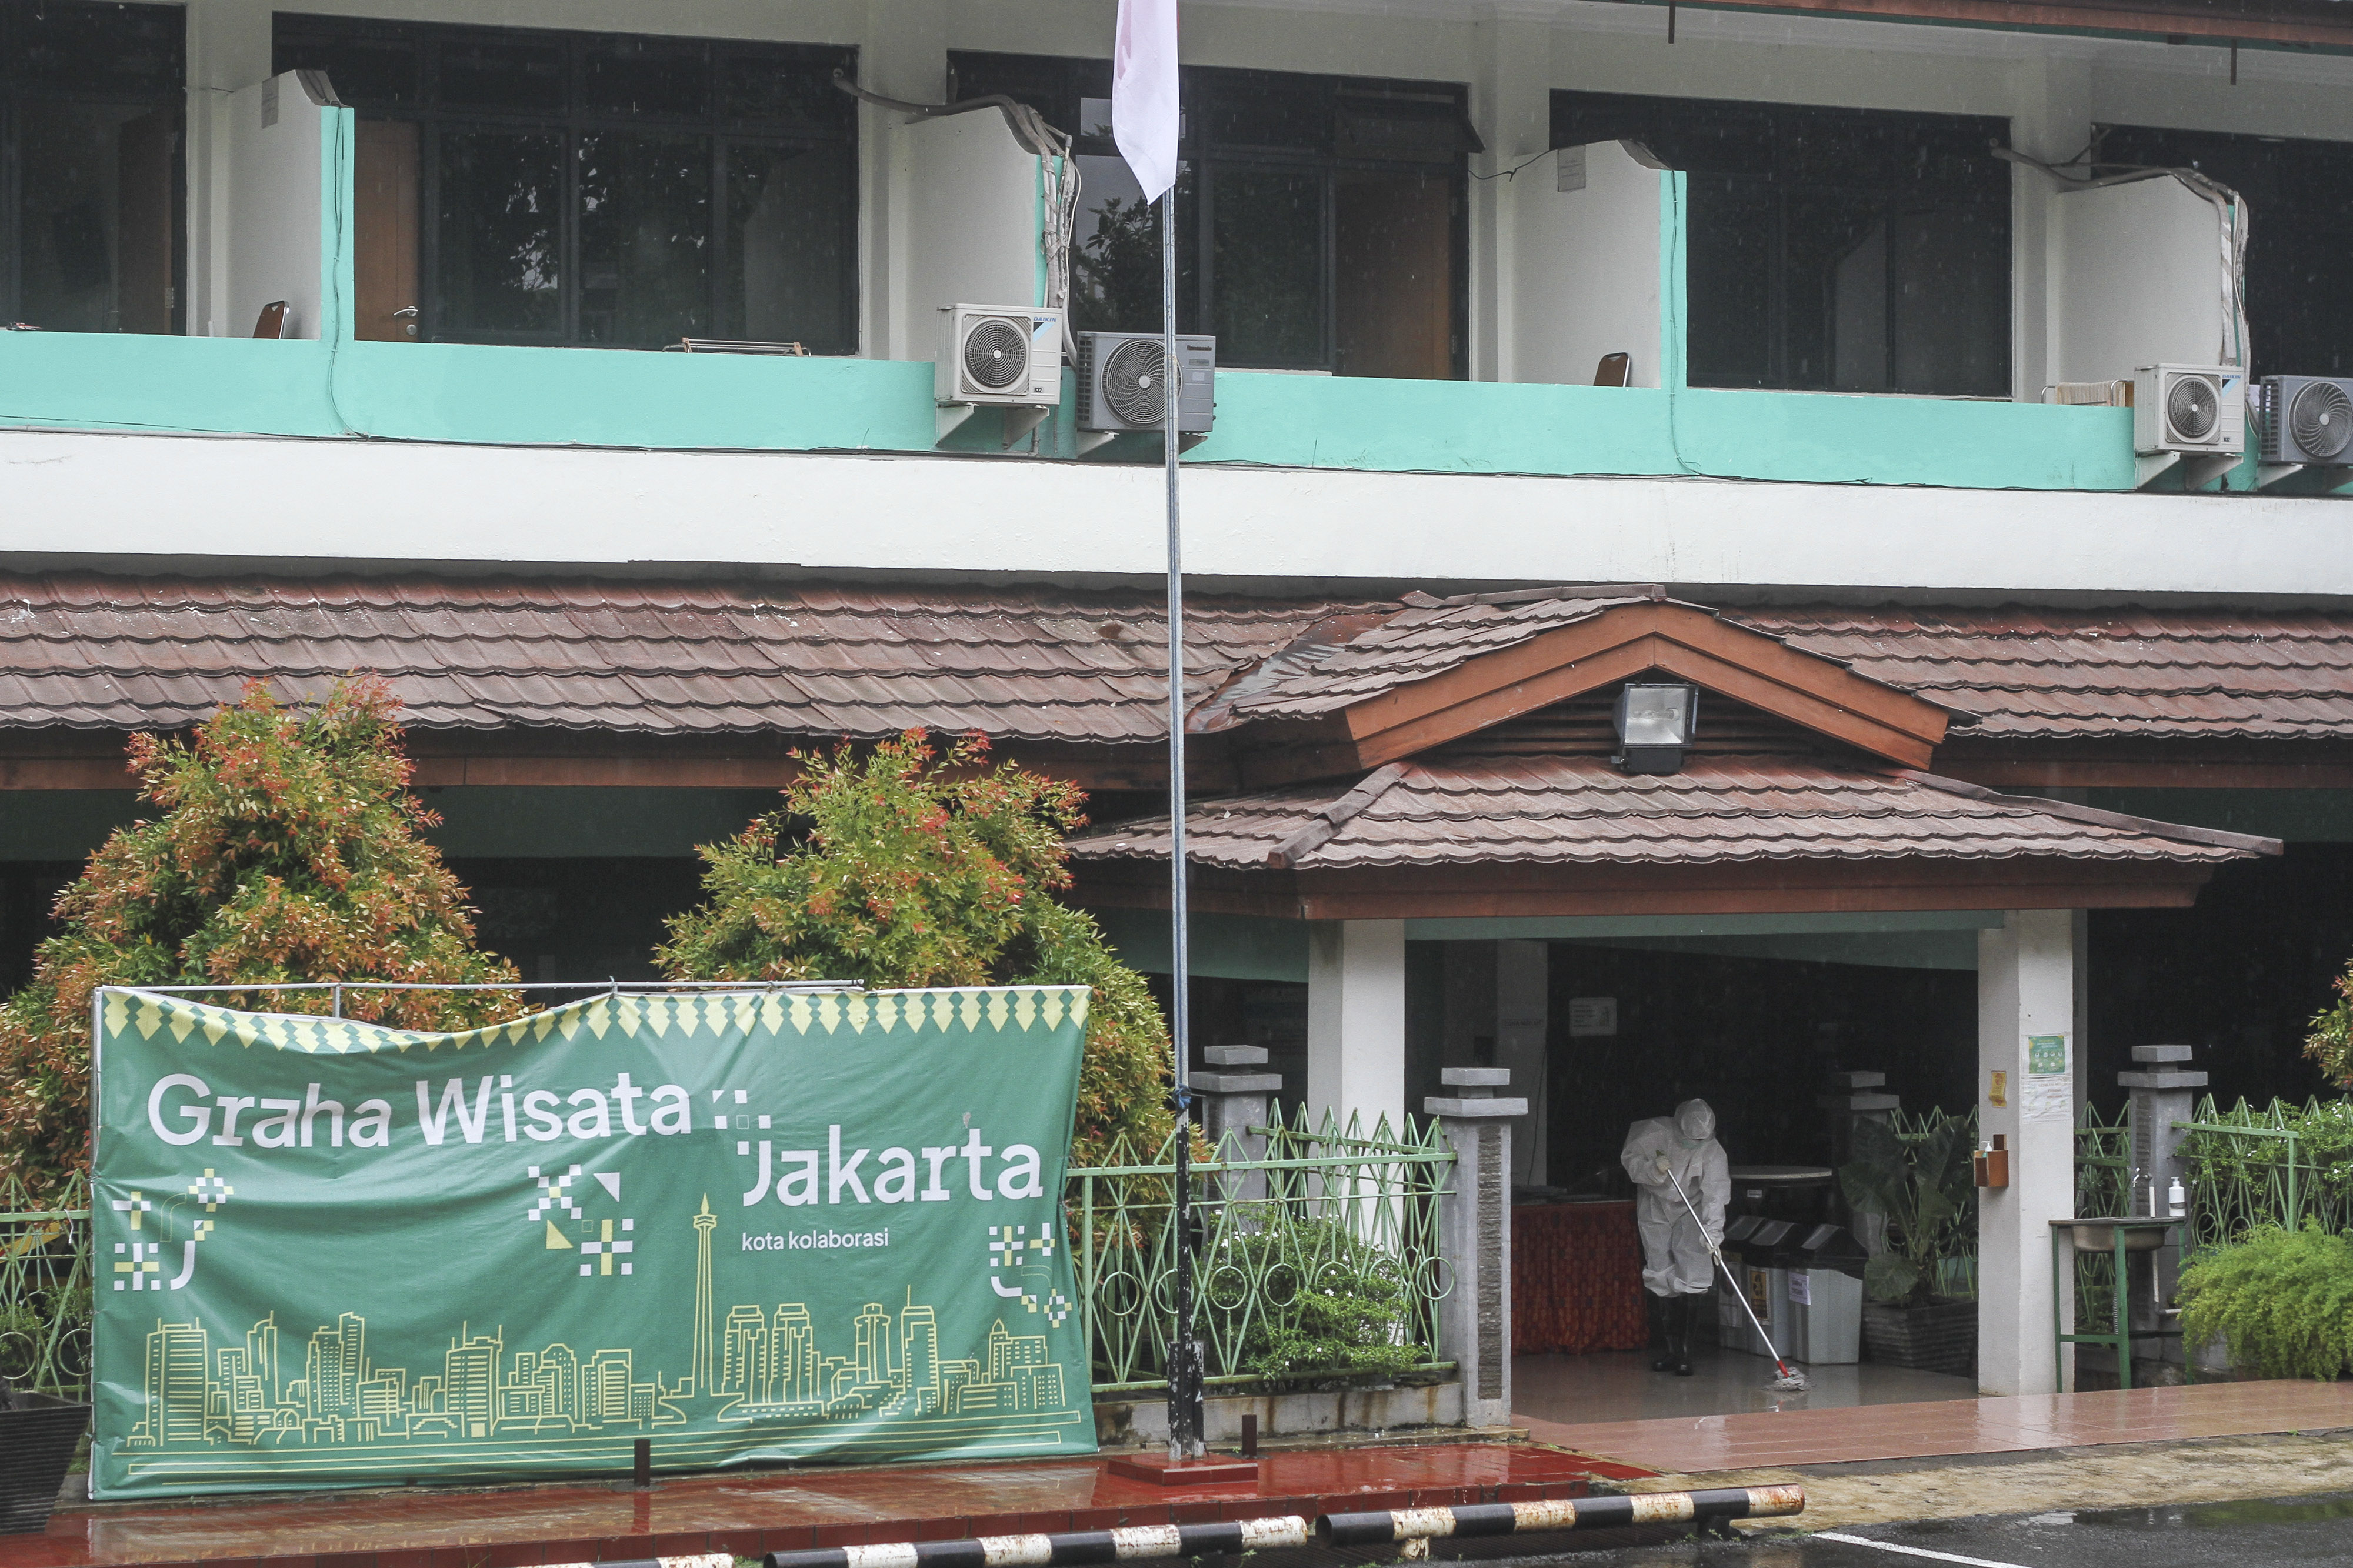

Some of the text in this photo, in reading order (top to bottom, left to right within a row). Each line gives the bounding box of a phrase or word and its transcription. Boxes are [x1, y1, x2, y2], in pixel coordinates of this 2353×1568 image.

[147, 1073, 691, 1148] Graha Wisata
[742, 1227, 889, 1251] kota kolaborasi
